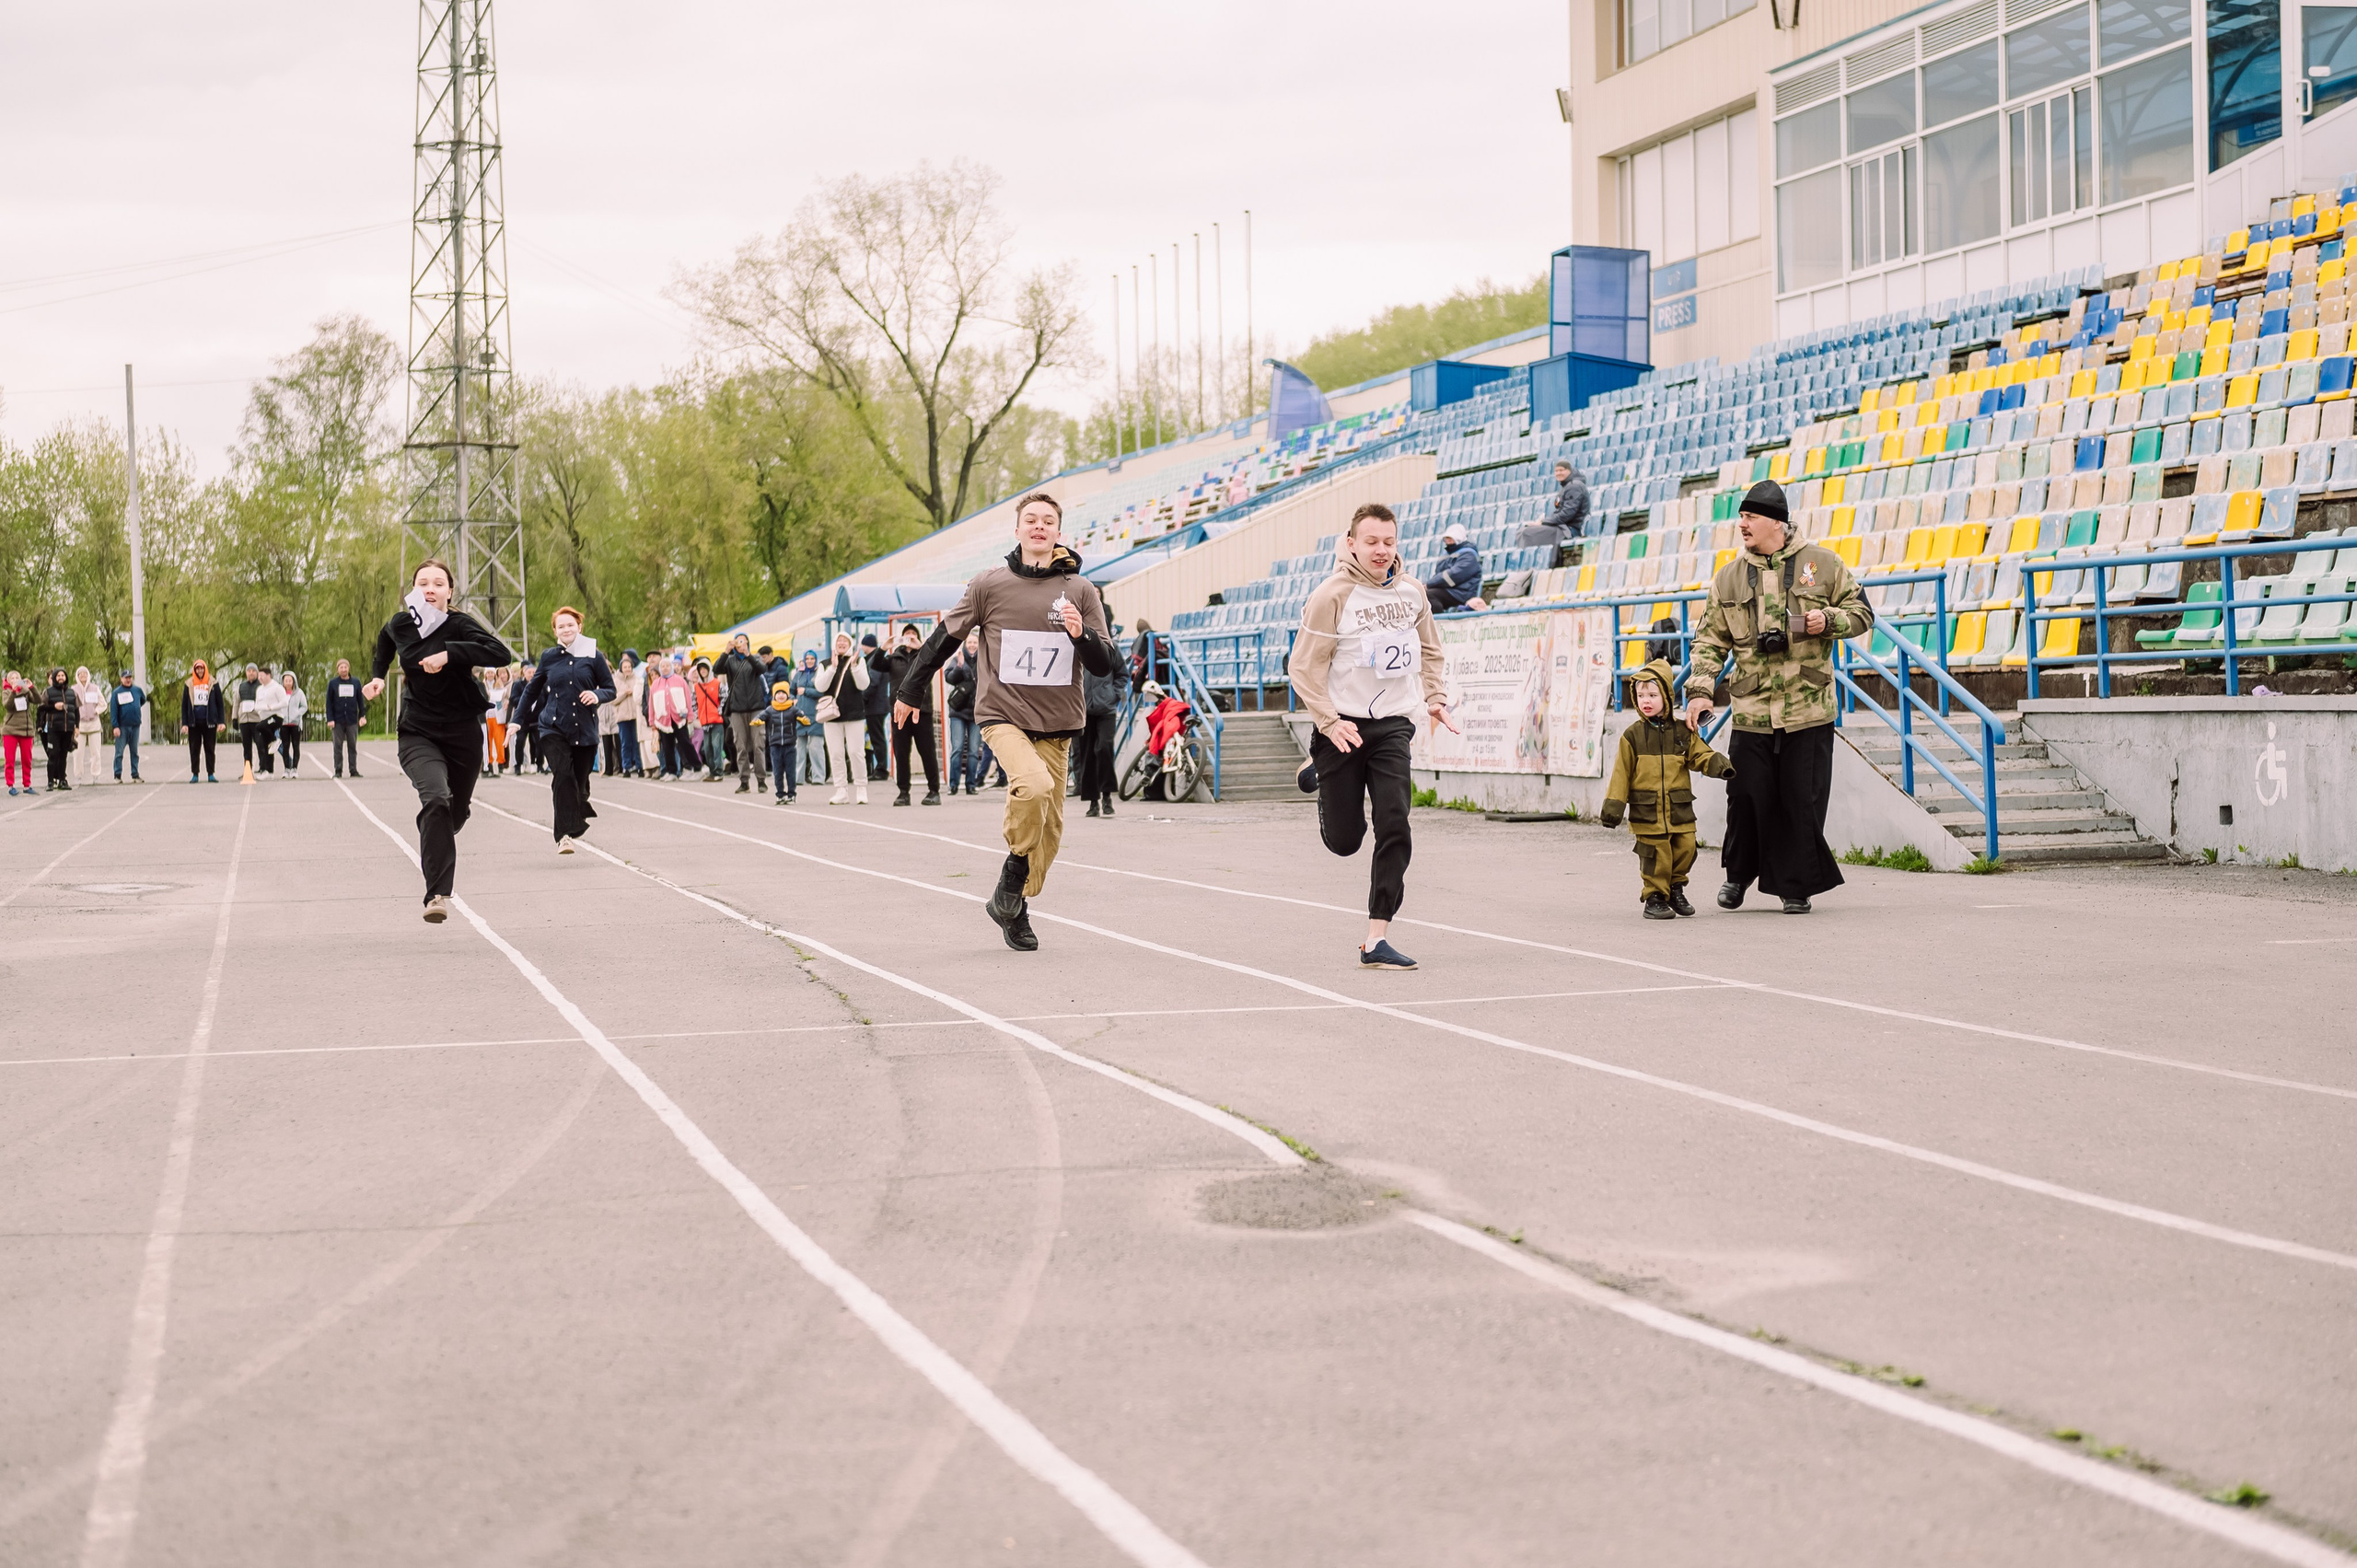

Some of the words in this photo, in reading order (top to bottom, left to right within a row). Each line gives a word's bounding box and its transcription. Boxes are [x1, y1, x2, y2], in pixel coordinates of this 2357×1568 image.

[1658, 301, 1691, 329] PRESS
[1015, 646, 1060, 678] 47
[1385, 643, 1411, 670] 25
[1484, 654, 1521, 673] 2025-2026
